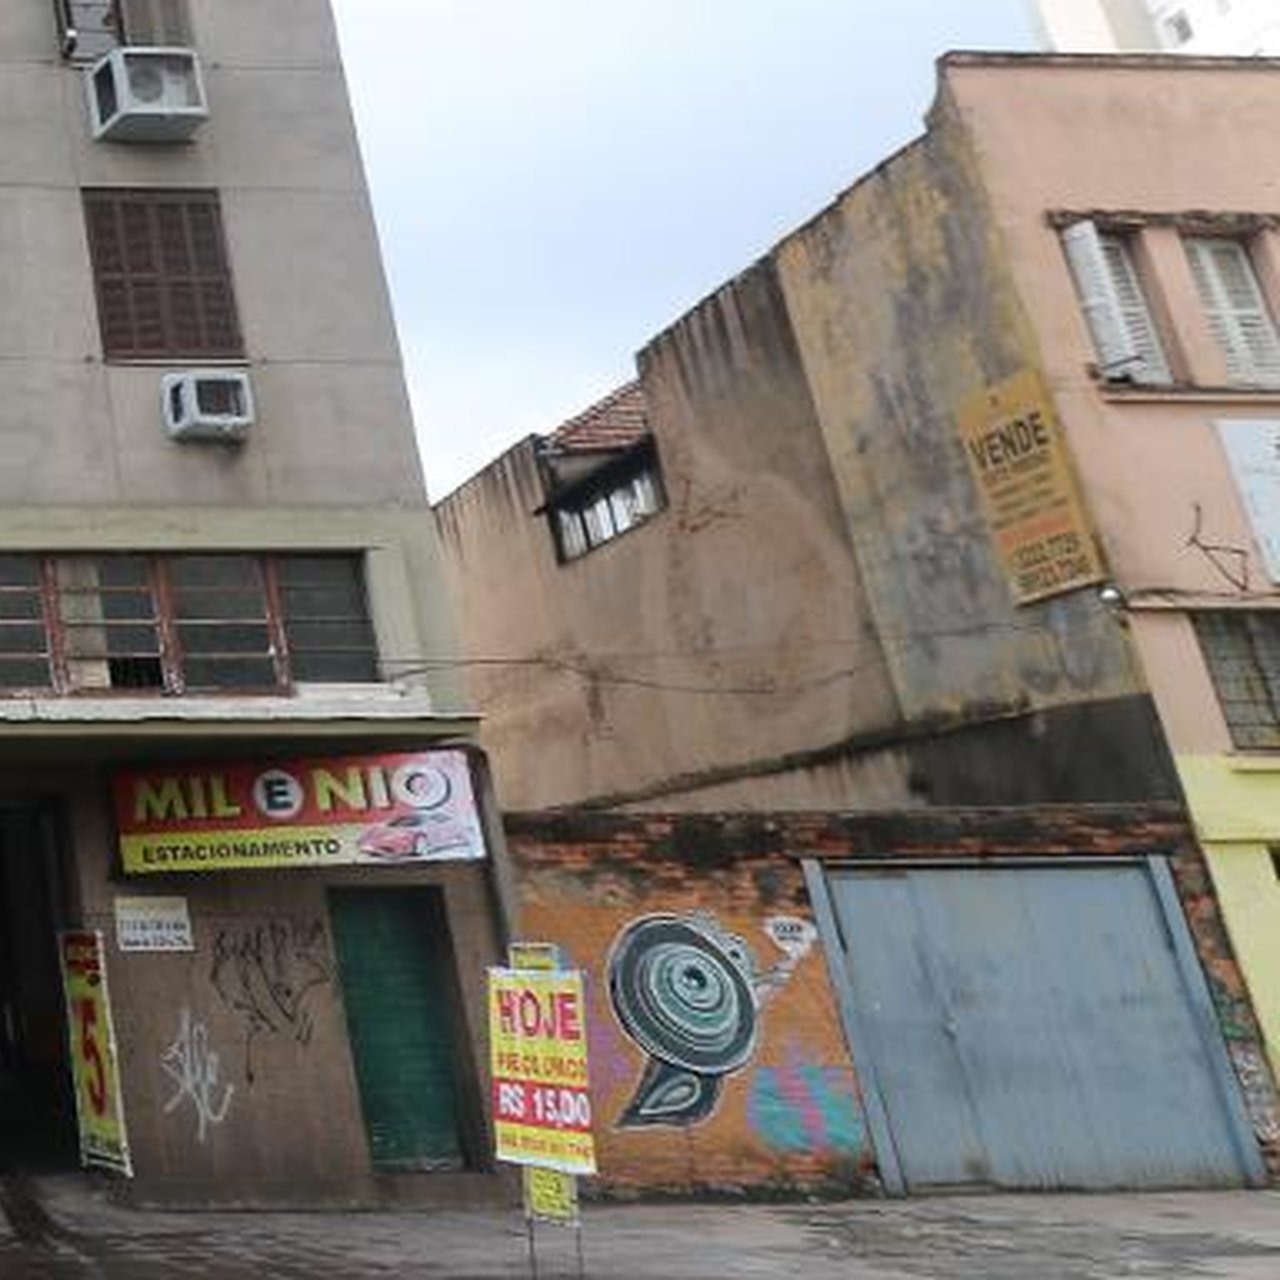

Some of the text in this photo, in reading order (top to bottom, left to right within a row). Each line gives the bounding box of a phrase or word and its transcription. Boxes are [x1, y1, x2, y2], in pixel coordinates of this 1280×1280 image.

[969, 412, 1051, 468] VENDE
[142, 837, 342, 864] ESTACIONAMENTO
[498, 988, 582, 1041] HOJE
[532, 1088, 590, 1128] 15,00
